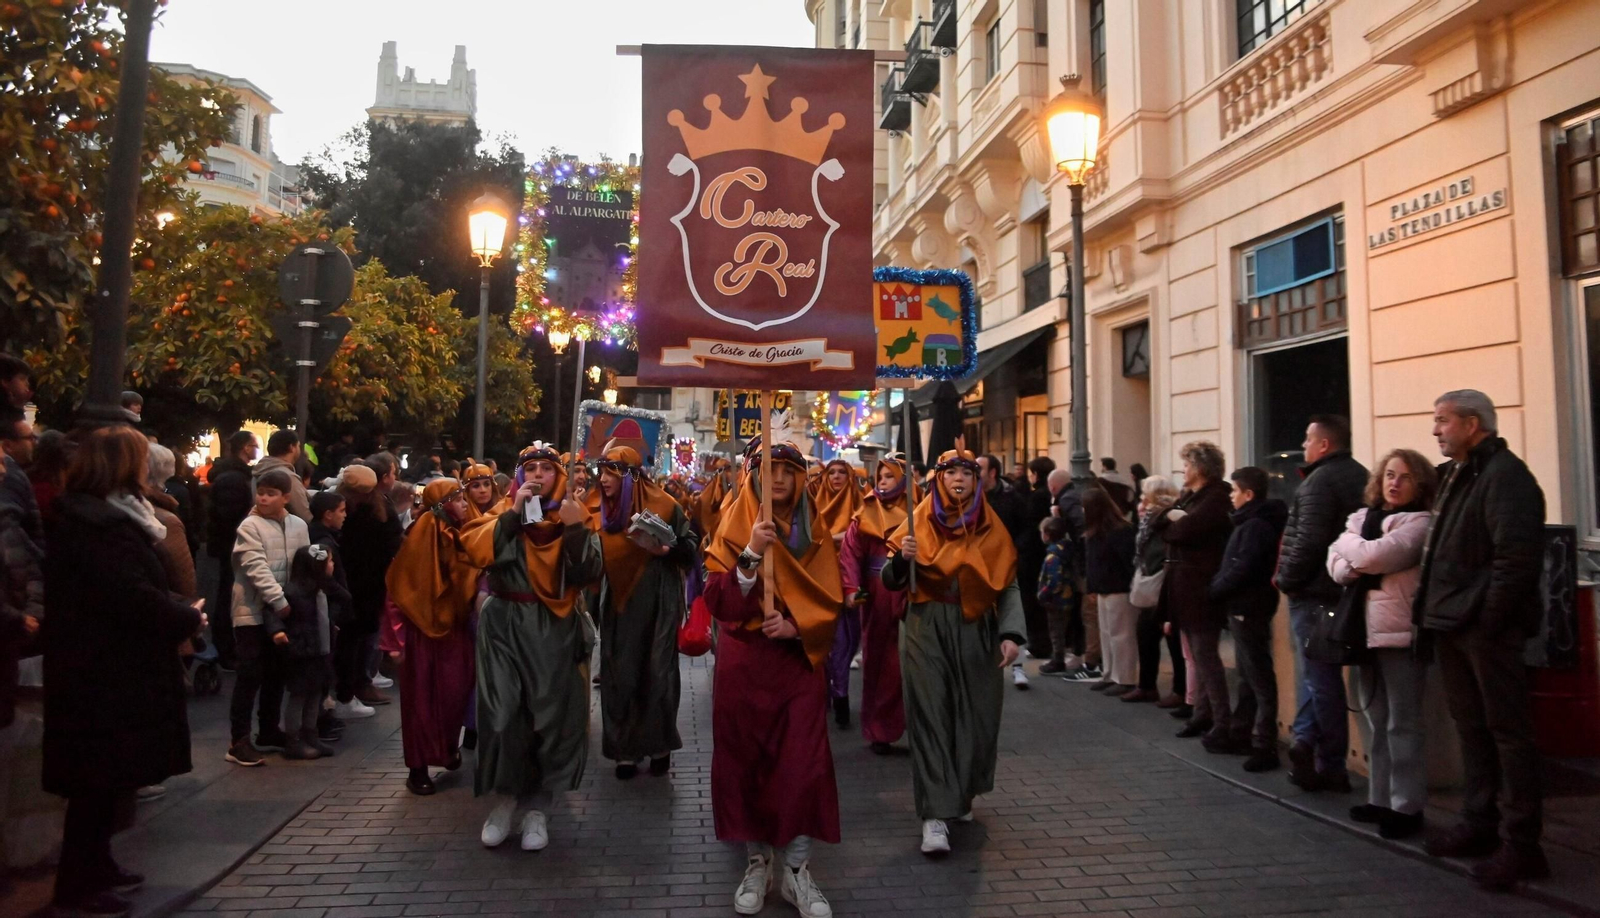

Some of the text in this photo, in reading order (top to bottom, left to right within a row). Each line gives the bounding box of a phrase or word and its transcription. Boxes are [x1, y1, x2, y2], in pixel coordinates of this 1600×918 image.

[567, 190, 582, 201] DE
[700, 166, 812, 229] Cartero
[1391, 177, 1472, 219] PLAZA DE
[552, 205, 566, 216] AL
[1369, 189, 1504, 248] LAS TENDILLAS
[714, 232, 815, 297] Real
[895, 301, 908, 318] M
[710, 343, 804, 363] Cristo de Gracia
[835, 403, 856, 429] M
